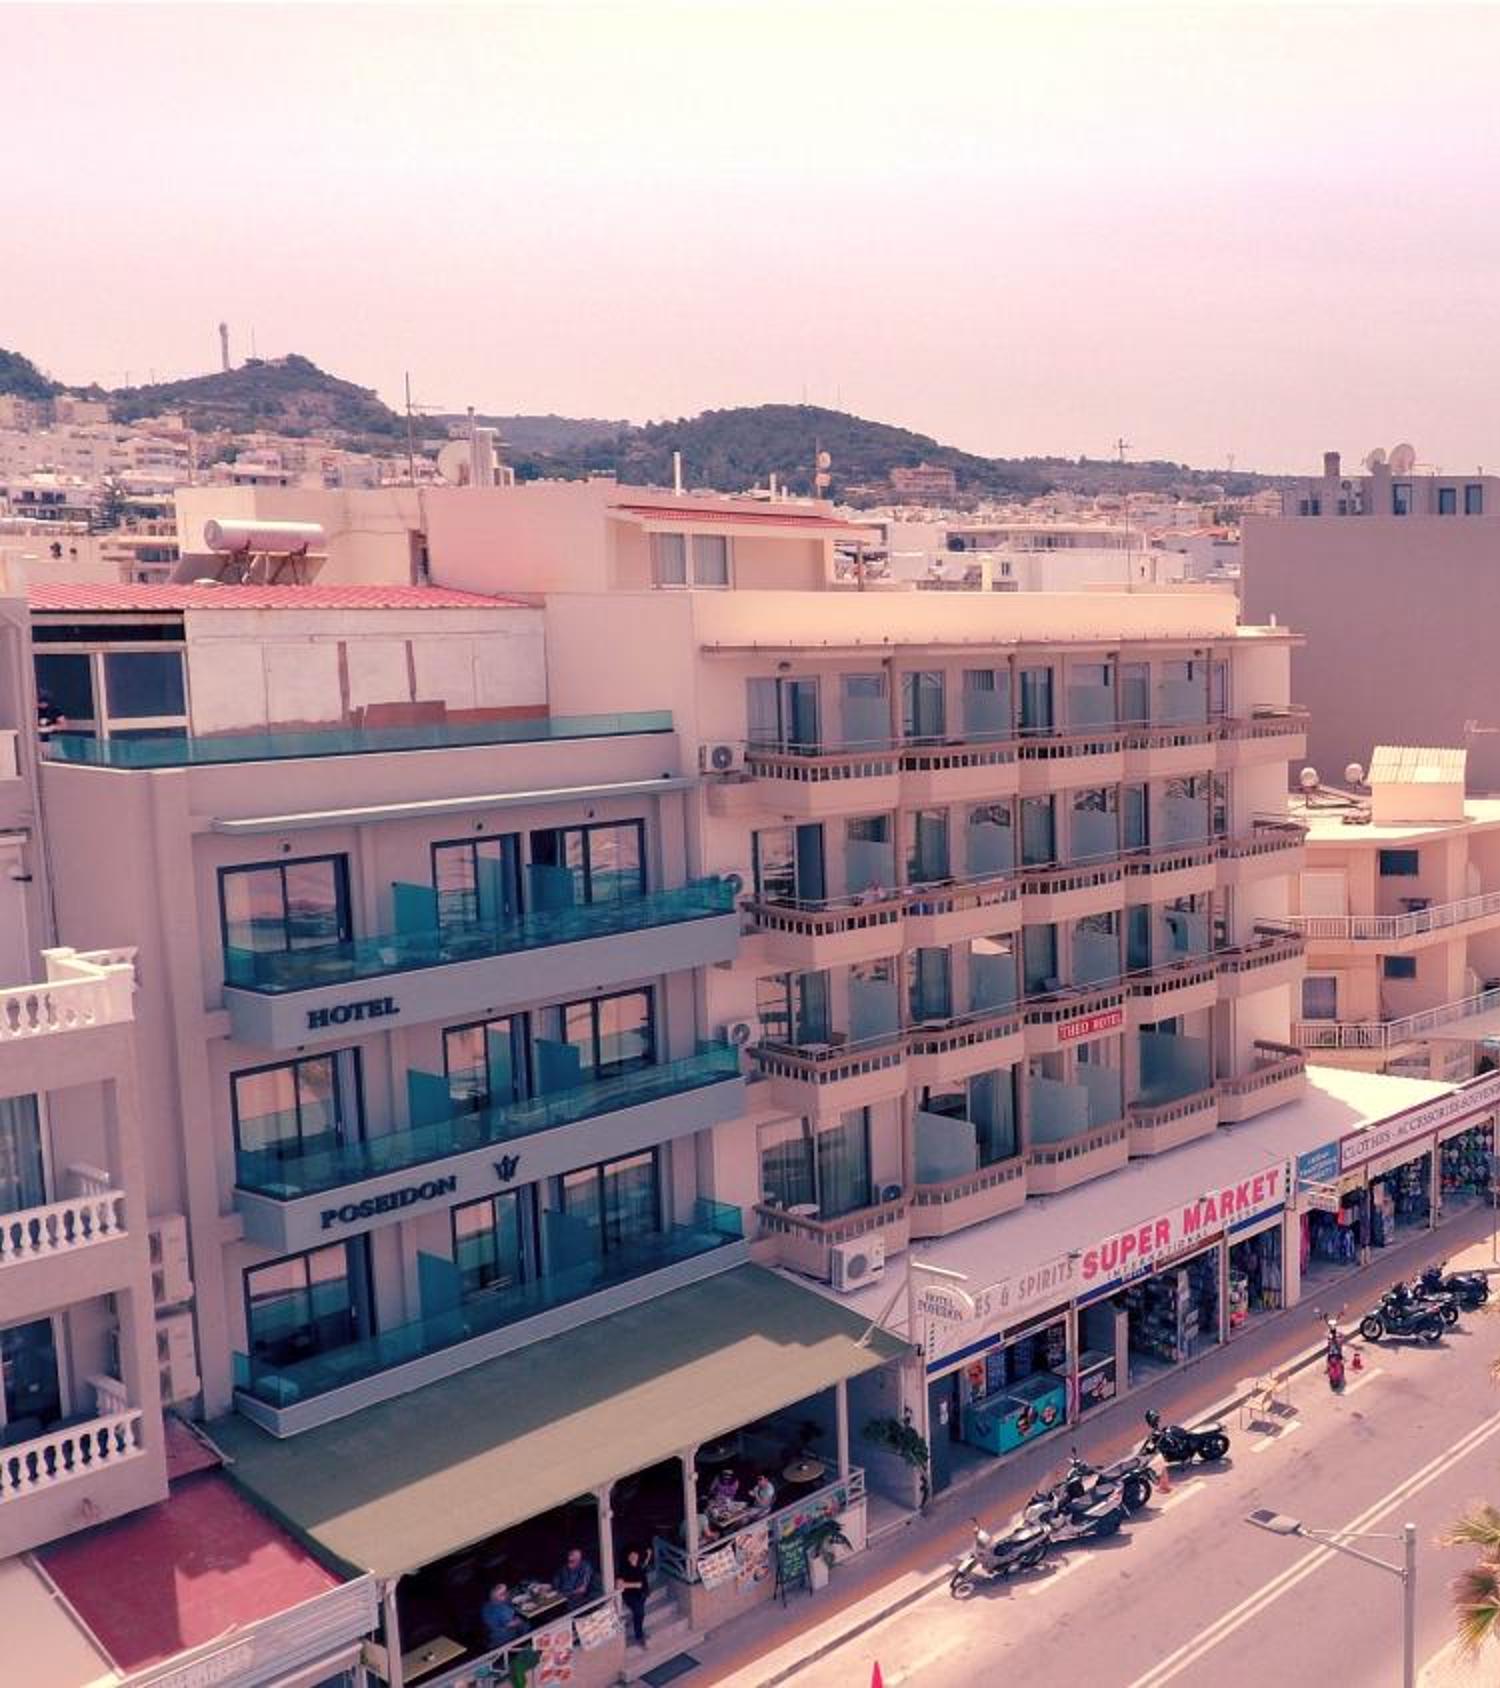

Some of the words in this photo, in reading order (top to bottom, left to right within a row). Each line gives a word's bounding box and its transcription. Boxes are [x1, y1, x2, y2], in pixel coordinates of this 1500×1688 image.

[307, 996, 401, 1030] HOTEL
[320, 1174, 458, 1228] POSEIDON
[1081, 1217, 1171, 1281] SUPER
[1183, 1169, 1280, 1235] MARKET
[1018, 1258, 1074, 1300] SPIRITS
